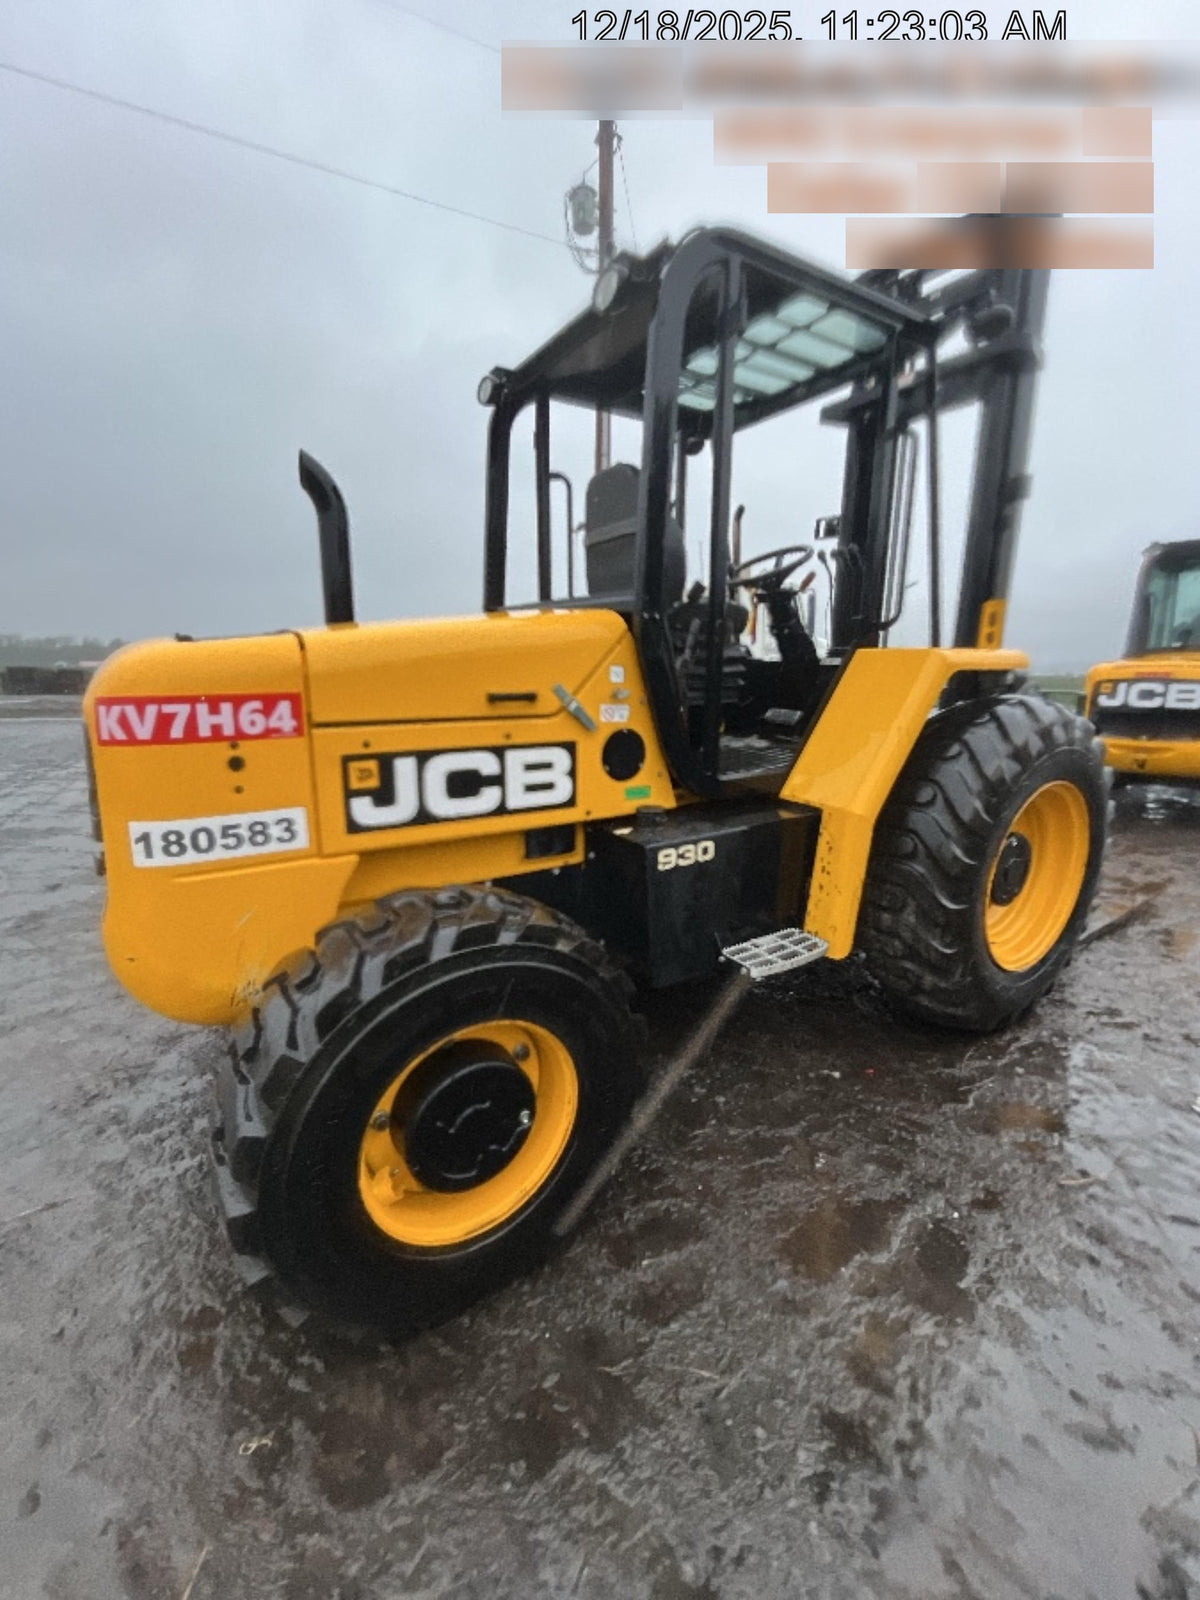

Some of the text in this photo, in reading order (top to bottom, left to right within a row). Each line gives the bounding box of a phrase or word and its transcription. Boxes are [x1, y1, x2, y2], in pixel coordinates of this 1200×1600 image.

[1097, 682, 1200, 709] JCB
[97, 700, 298, 741] KV7H64
[349, 745, 574, 828] JCB
[134, 817, 298, 859] 180583
[657, 840, 716, 871] 930
